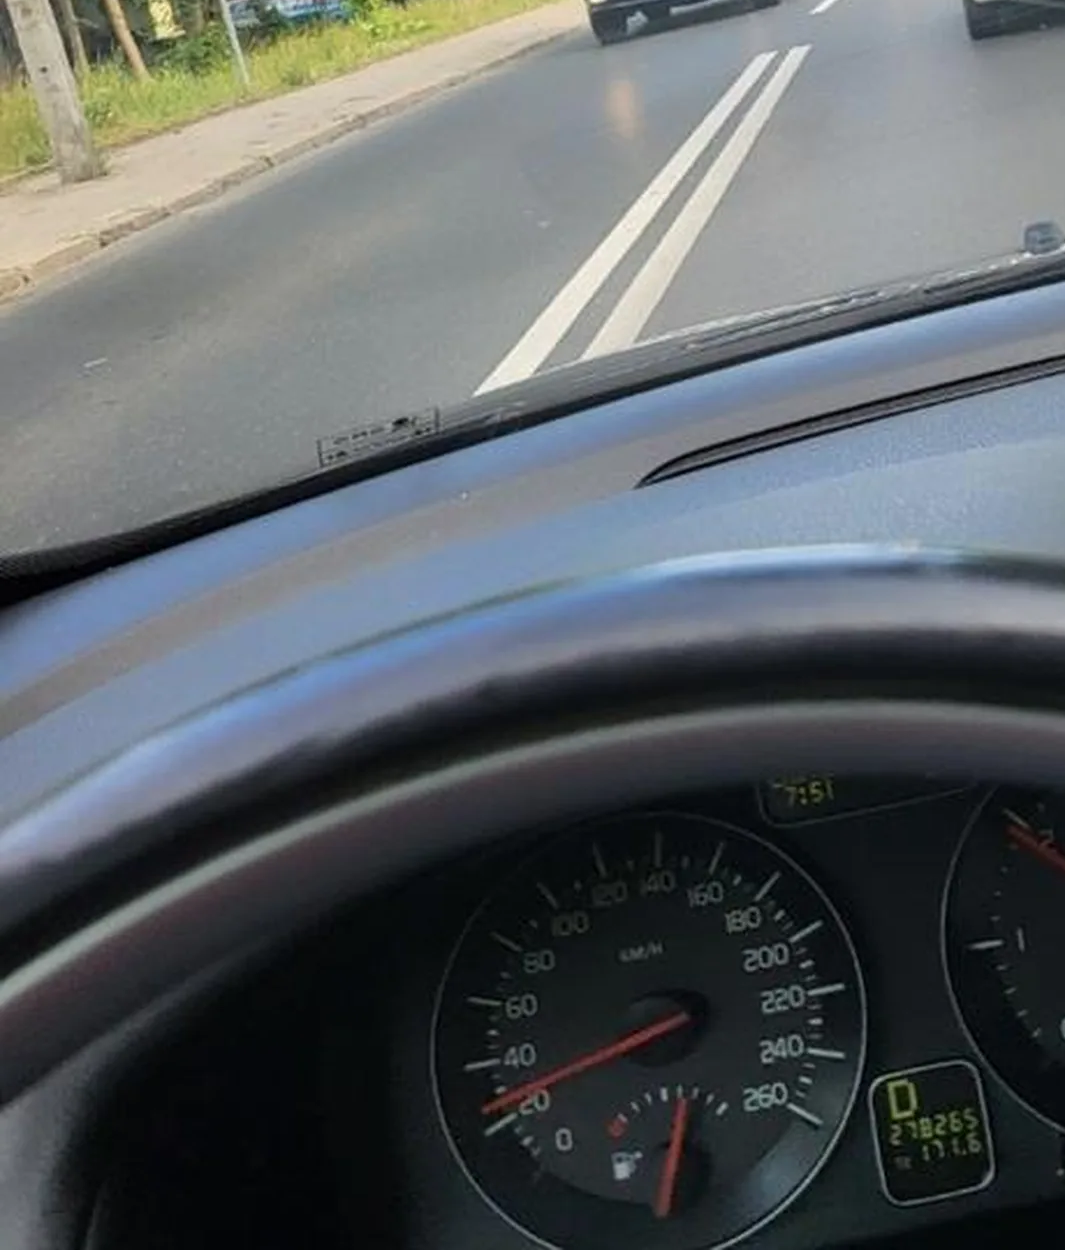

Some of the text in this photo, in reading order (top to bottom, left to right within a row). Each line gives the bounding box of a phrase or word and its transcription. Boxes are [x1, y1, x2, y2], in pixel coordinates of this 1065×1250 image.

[686, 880, 724, 908] 160
[551, 910, 589, 936] 100
[725, 906, 761, 935] 180
[1016, 927, 1026, 951] 1
[523, 950, 555, 973] 80
[743, 942, 791, 972] 200
[505, 994, 538, 1018] 60
[760, 985, 806, 1014] 220
[503, 1043, 536, 1069] 40
[759, 1034, 805, 1064] 240
[517, 1090, 551, 1117] 20
[743, 1082, 788, 1112] 260
[886, 1078, 918, 1120] D
[555, 1127, 573, 1151] 0
